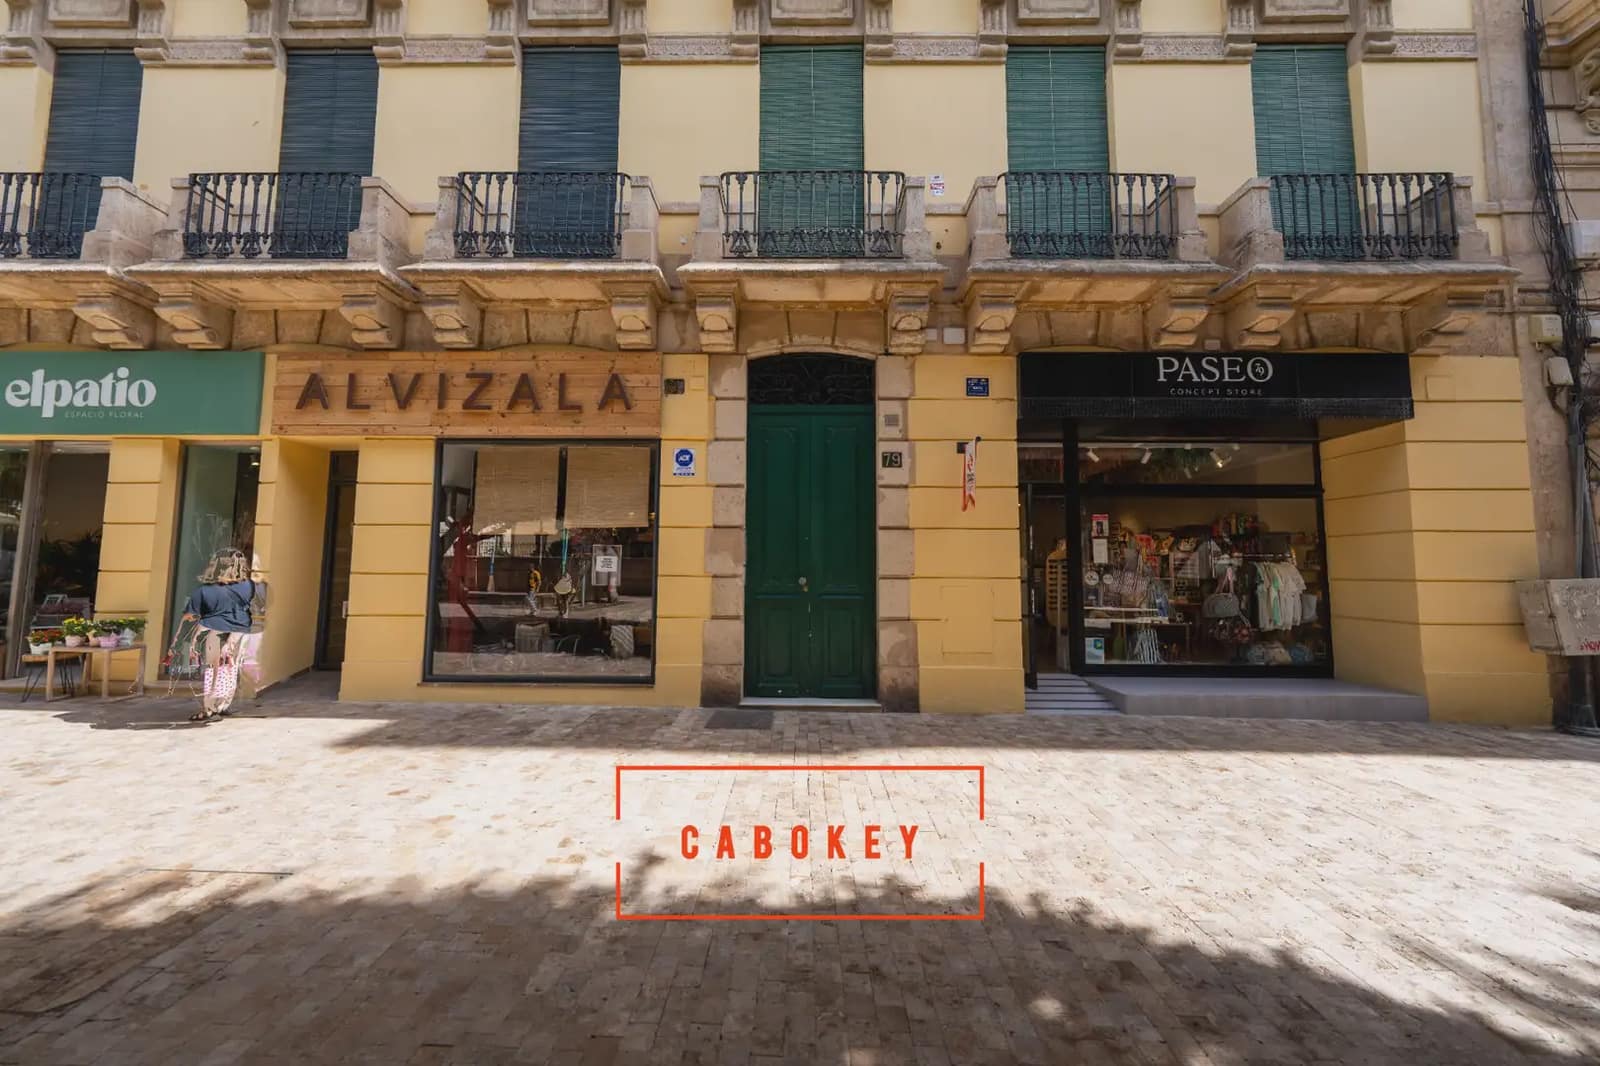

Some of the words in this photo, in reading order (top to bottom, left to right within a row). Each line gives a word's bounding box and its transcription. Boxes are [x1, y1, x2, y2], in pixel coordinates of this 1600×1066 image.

[1156, 356, 1273, 382] PASEO
[5, 366, 157, 418] elpatio
[295, 372, 633, 411] ALVIZALA
[1169, 387, 1220, 396] CONCEPT
[1226, 387, 1263, 396] STORE
[65, 410, 104, 419] ESPACIO
[109, 410, 145, 418] FLORAL
[883, 453, 900, 467] 79
